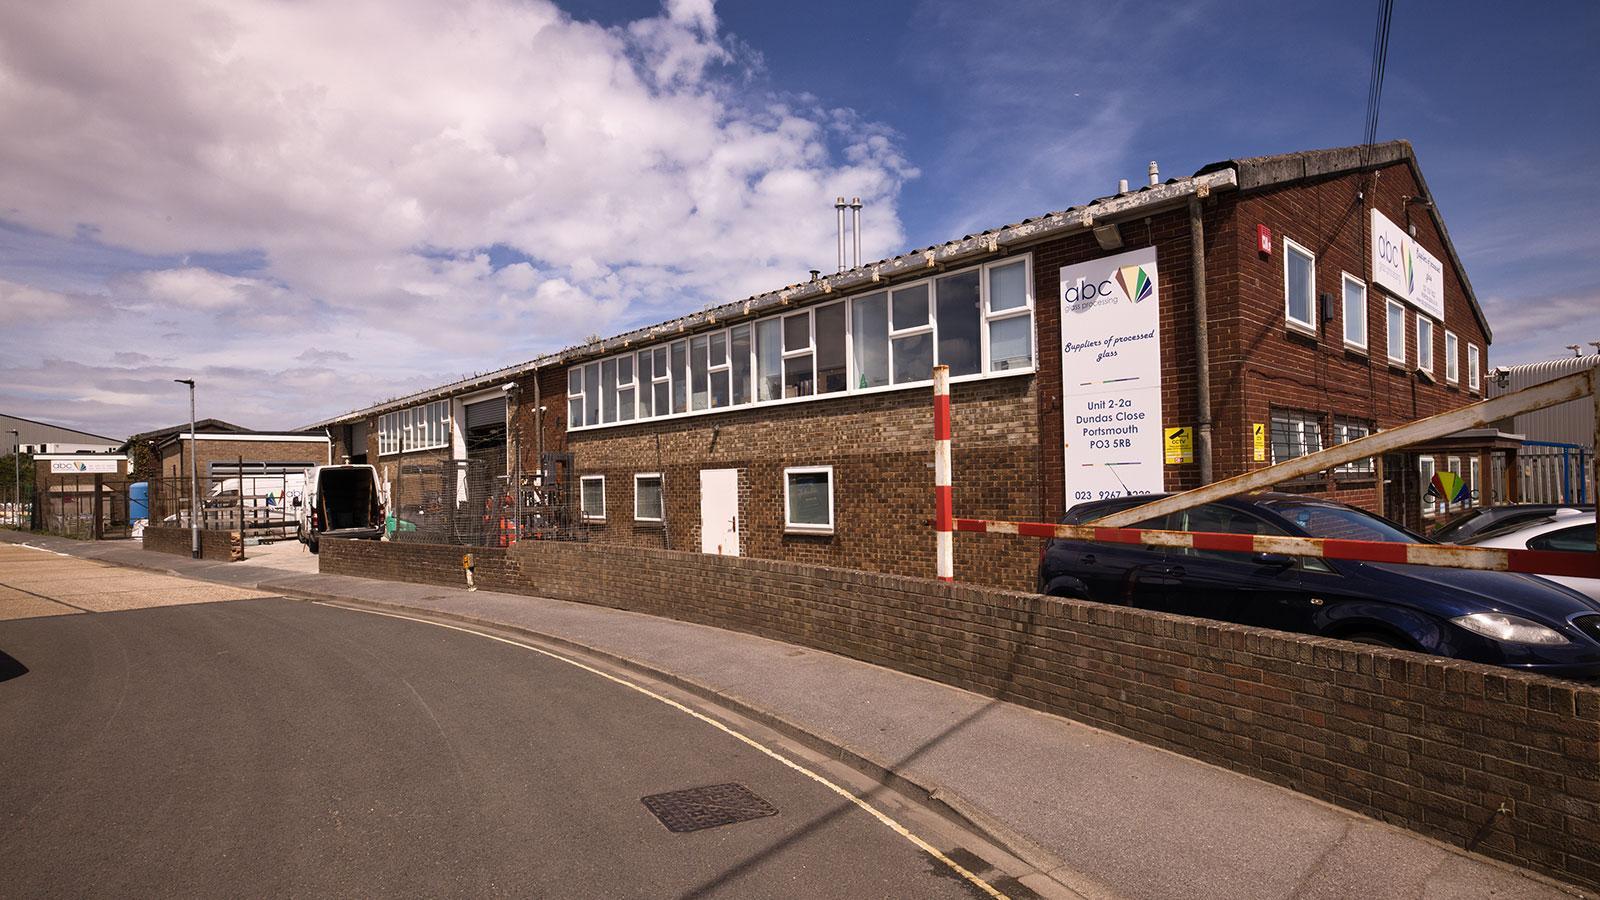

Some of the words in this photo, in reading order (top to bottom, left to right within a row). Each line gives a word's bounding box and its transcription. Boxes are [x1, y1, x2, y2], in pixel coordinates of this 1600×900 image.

[1378, 231, 1398, 268] abc
[1065, 280, 1112, 302] abc
[1064, 340, 1101, 353] Suppliers
[1104, 336, 1114, 348] of
[1113, 329, 1155, 347] processed
[1096, 350, 1118, 362] glass
[1087, 401, 1106, 410] Unit
[1108, 398, 1131, 409] 2-2a
[1076, 413, 1113, 424] Dundas
[1115, 411, 1145, 421] Close
[1083, 424, 1139, 437] Portsmouth
[1090, 439, 1110, 449] PO3
[1113, 438, 1132, 448] 5RB
[1074, 491, 1092, 500] 023
[1098, 490, 1121, 500] 9267
